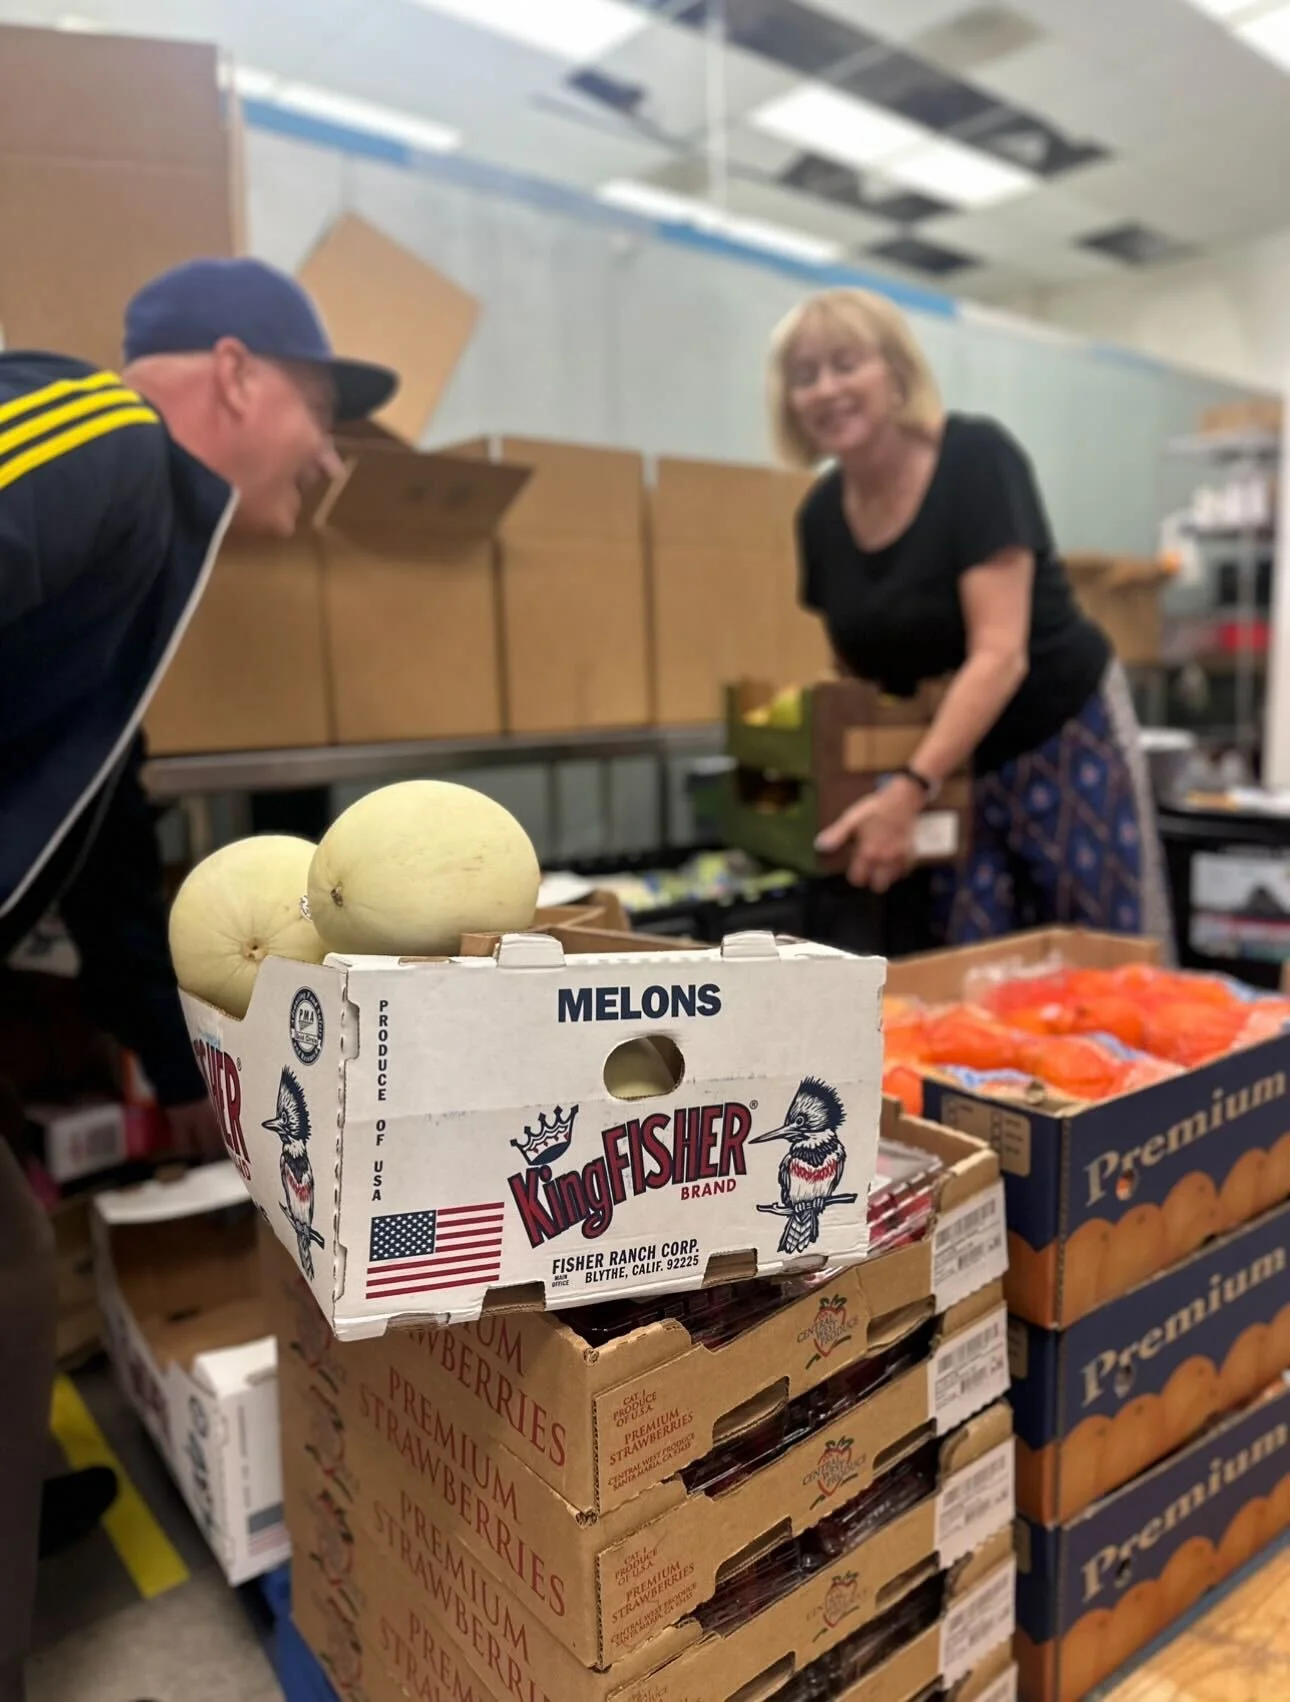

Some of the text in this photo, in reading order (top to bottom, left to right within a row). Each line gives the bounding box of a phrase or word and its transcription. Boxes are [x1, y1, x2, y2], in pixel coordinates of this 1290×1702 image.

[558, 983, 722, 1022] MELONS
[372, 1000, 389, 1201] PRODUCE OF USA
[1083, 1070, 1286, 1208] Premium
[508, 1102, 753, 1248] KingFISHER
[680, 1178, 737, 1201] BRAND
[551, 1280, 570, 1288] OFFICE
[552, 1238, 700, 1275] FISHER RANCH CORP.
[585, 1254, 700, 1284] BLYTHE, CALIF. 92225
[1081, 1246, 1286, 1408] Premium
[409, 1328, 567, 1467] WBERRIES
[613, 1391, 657, 1421] PRODUCE
[616, 1414, 629, 1427] OF
[389, 1365, 522, 1525] PREMIUM
[609, 1411, 694, 1466] STRAWBERRIES
[625, 1407, 680, 1445] PREMIUM
[608, 1432, 695, 1485] CENTRAL WEST PRODUCE
[359, 1381, 566, 1617] STRAWBERRIES
[1081, 1423, 1289, 1604] Premium
[401, 1489, 530, 1665] PREMIUM
[615, 1547, 658, 1580] PRODUCE
[626, 1560, 681, 1602] PREMIUM
[612, 1562, 695, 1624] STRAWBERRIES
[409, 1609, 478, 1702] PREM
